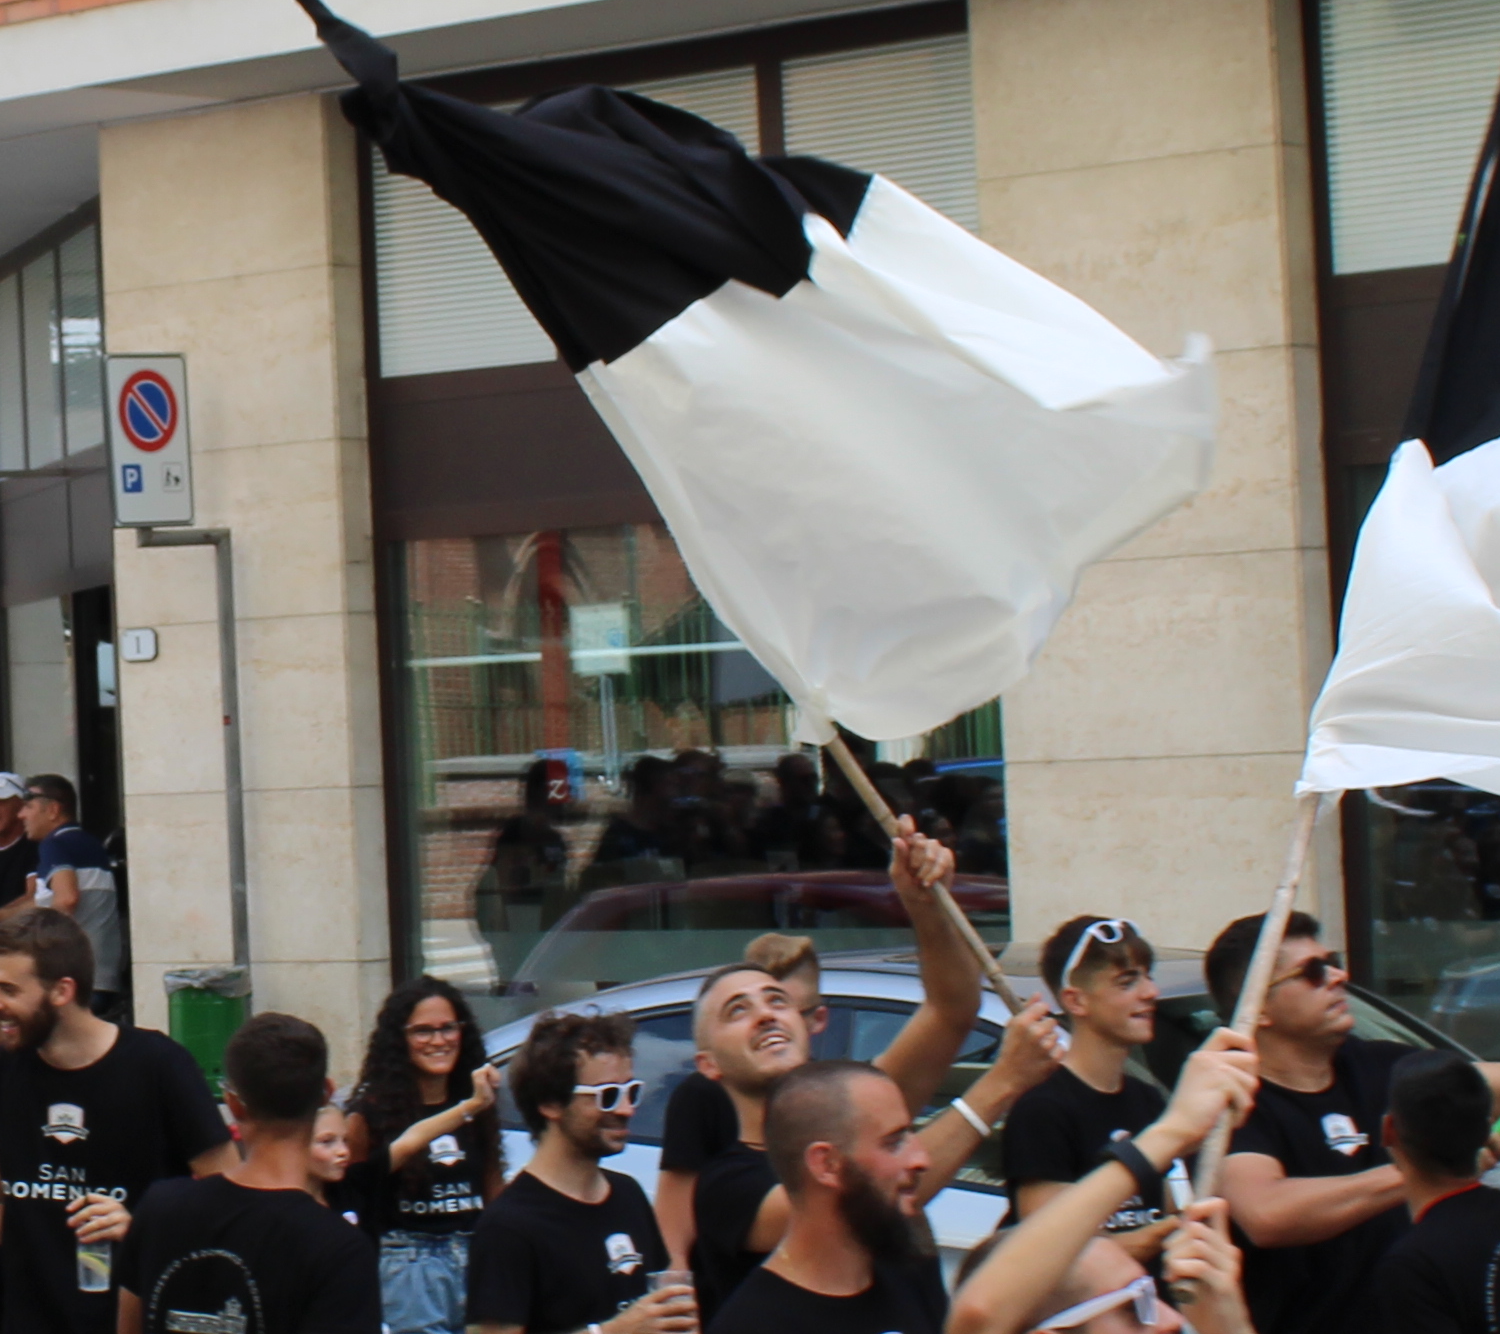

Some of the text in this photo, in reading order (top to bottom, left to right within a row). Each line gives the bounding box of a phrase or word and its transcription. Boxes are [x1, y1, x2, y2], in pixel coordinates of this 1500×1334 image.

[125, 468, 139, 489] P
[38, 1163, 87, 1183] SAN
[431, 1182, 472, 1198] SAN
